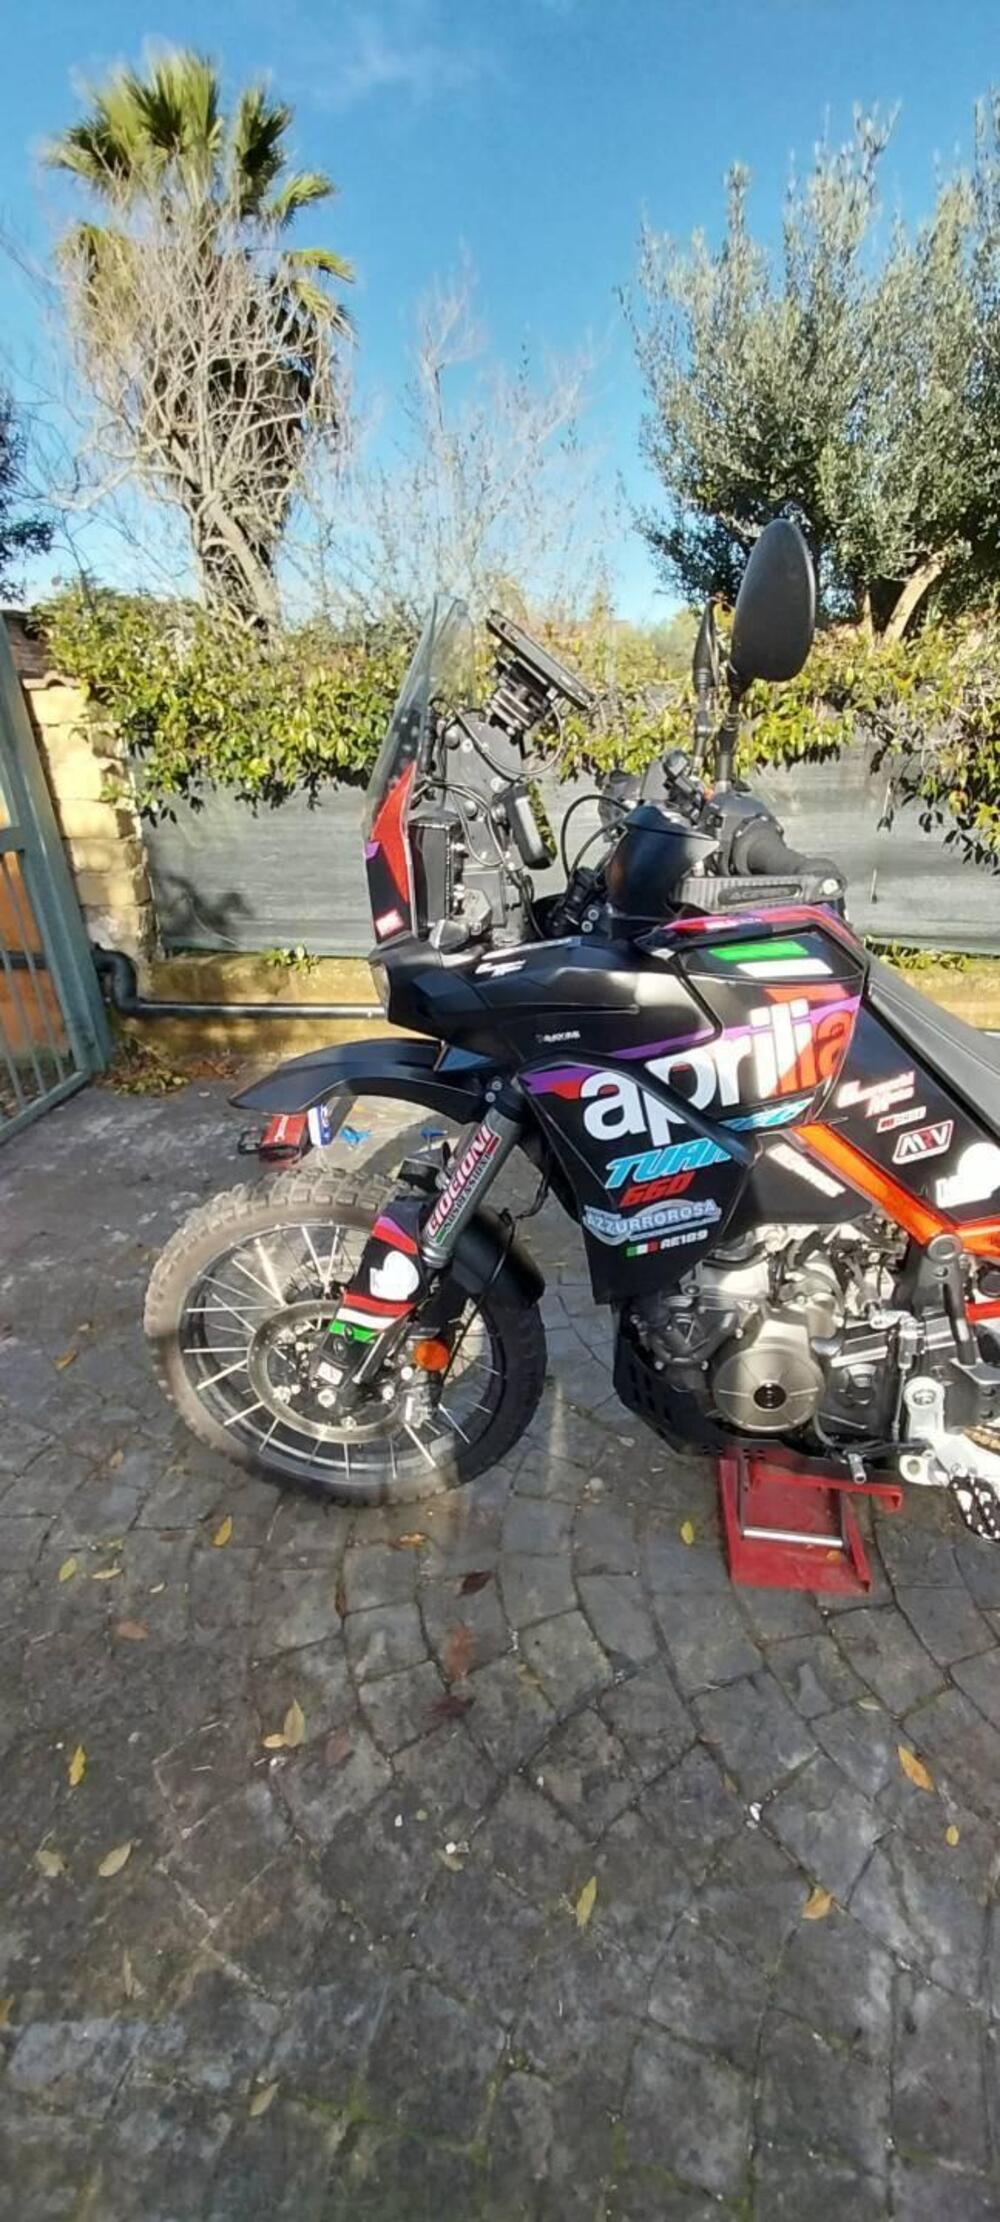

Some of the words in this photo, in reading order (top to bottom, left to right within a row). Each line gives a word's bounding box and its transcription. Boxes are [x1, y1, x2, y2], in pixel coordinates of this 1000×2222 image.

[580, 998, 853, 1147] aprilia
[619, 1171, 697, 1208] 660
[586, 1199, 720, 1237] AZZURROROSA
